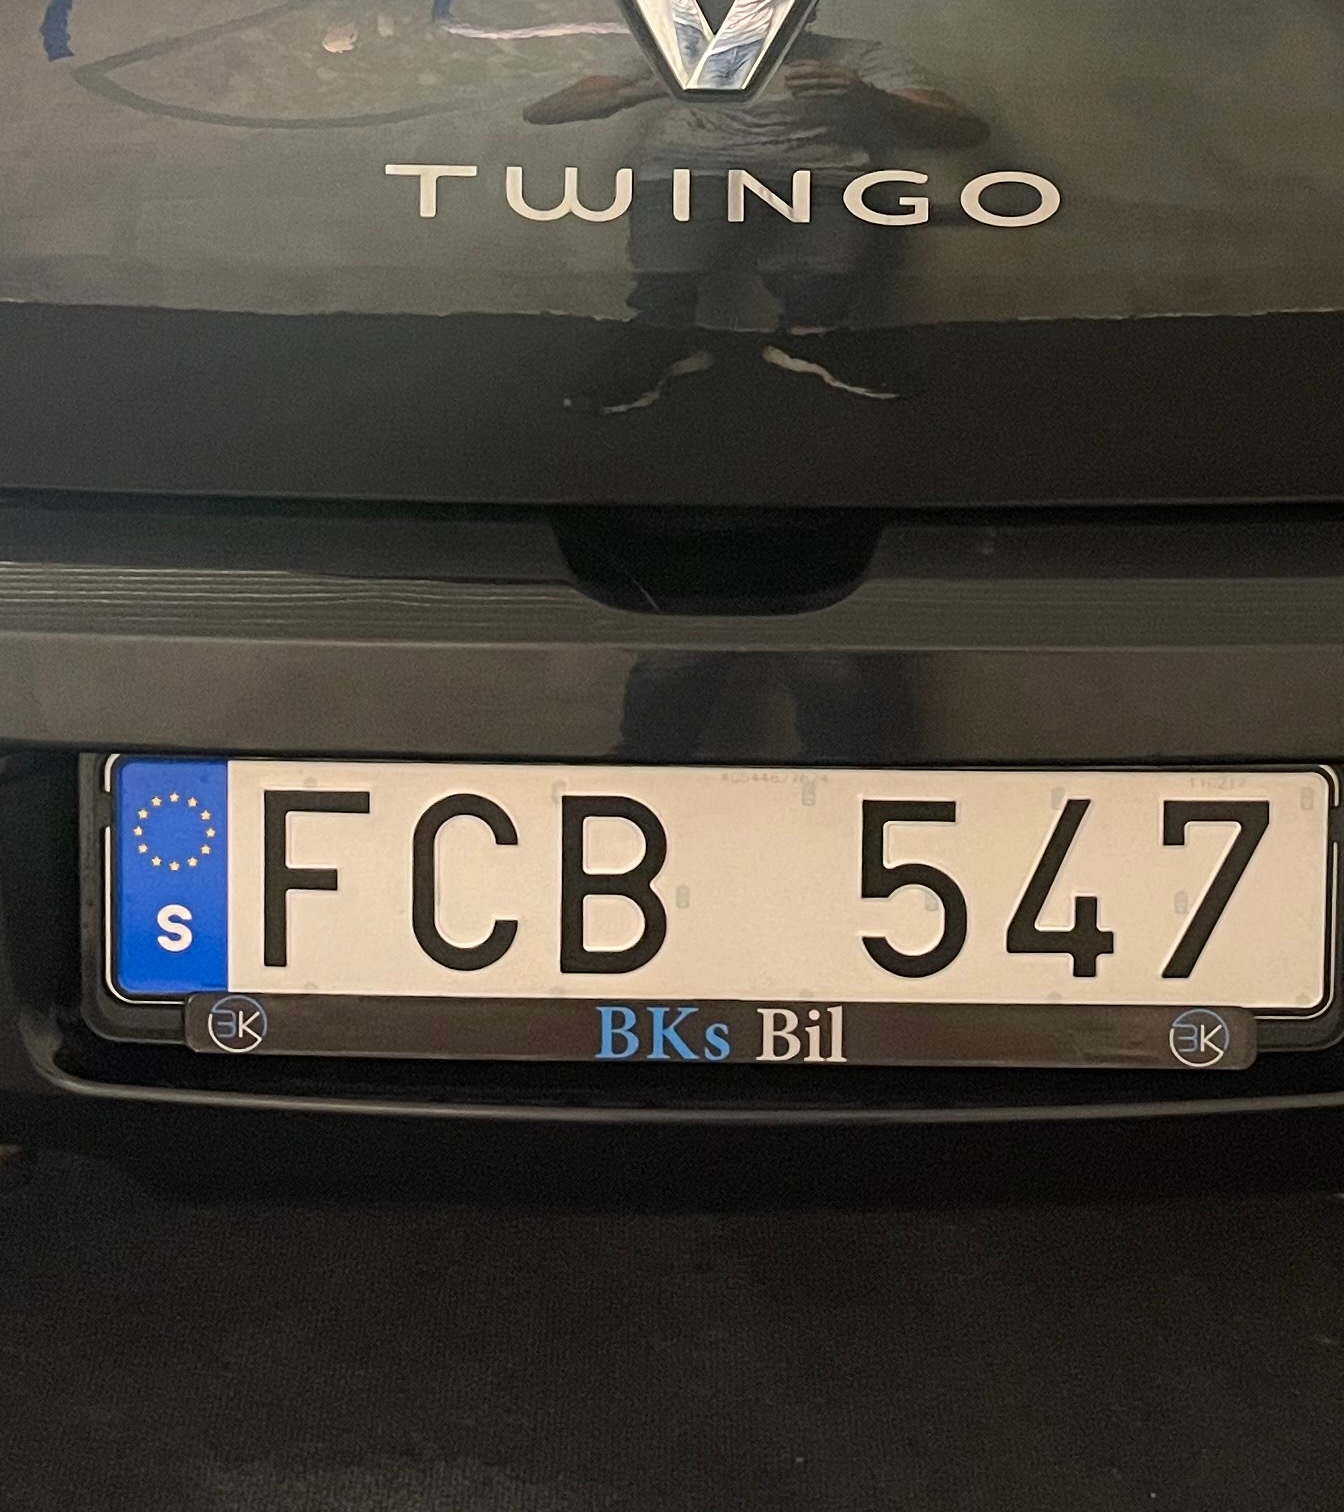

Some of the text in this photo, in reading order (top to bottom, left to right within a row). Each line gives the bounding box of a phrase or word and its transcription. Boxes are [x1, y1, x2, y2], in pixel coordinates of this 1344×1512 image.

[384, 163, 1061, 227] TWINGO
[263, 789, 1271, 979] FCB 547
[156, 904, 193, 952] S
[595, 1004, 848, 1063] BKs Bil
